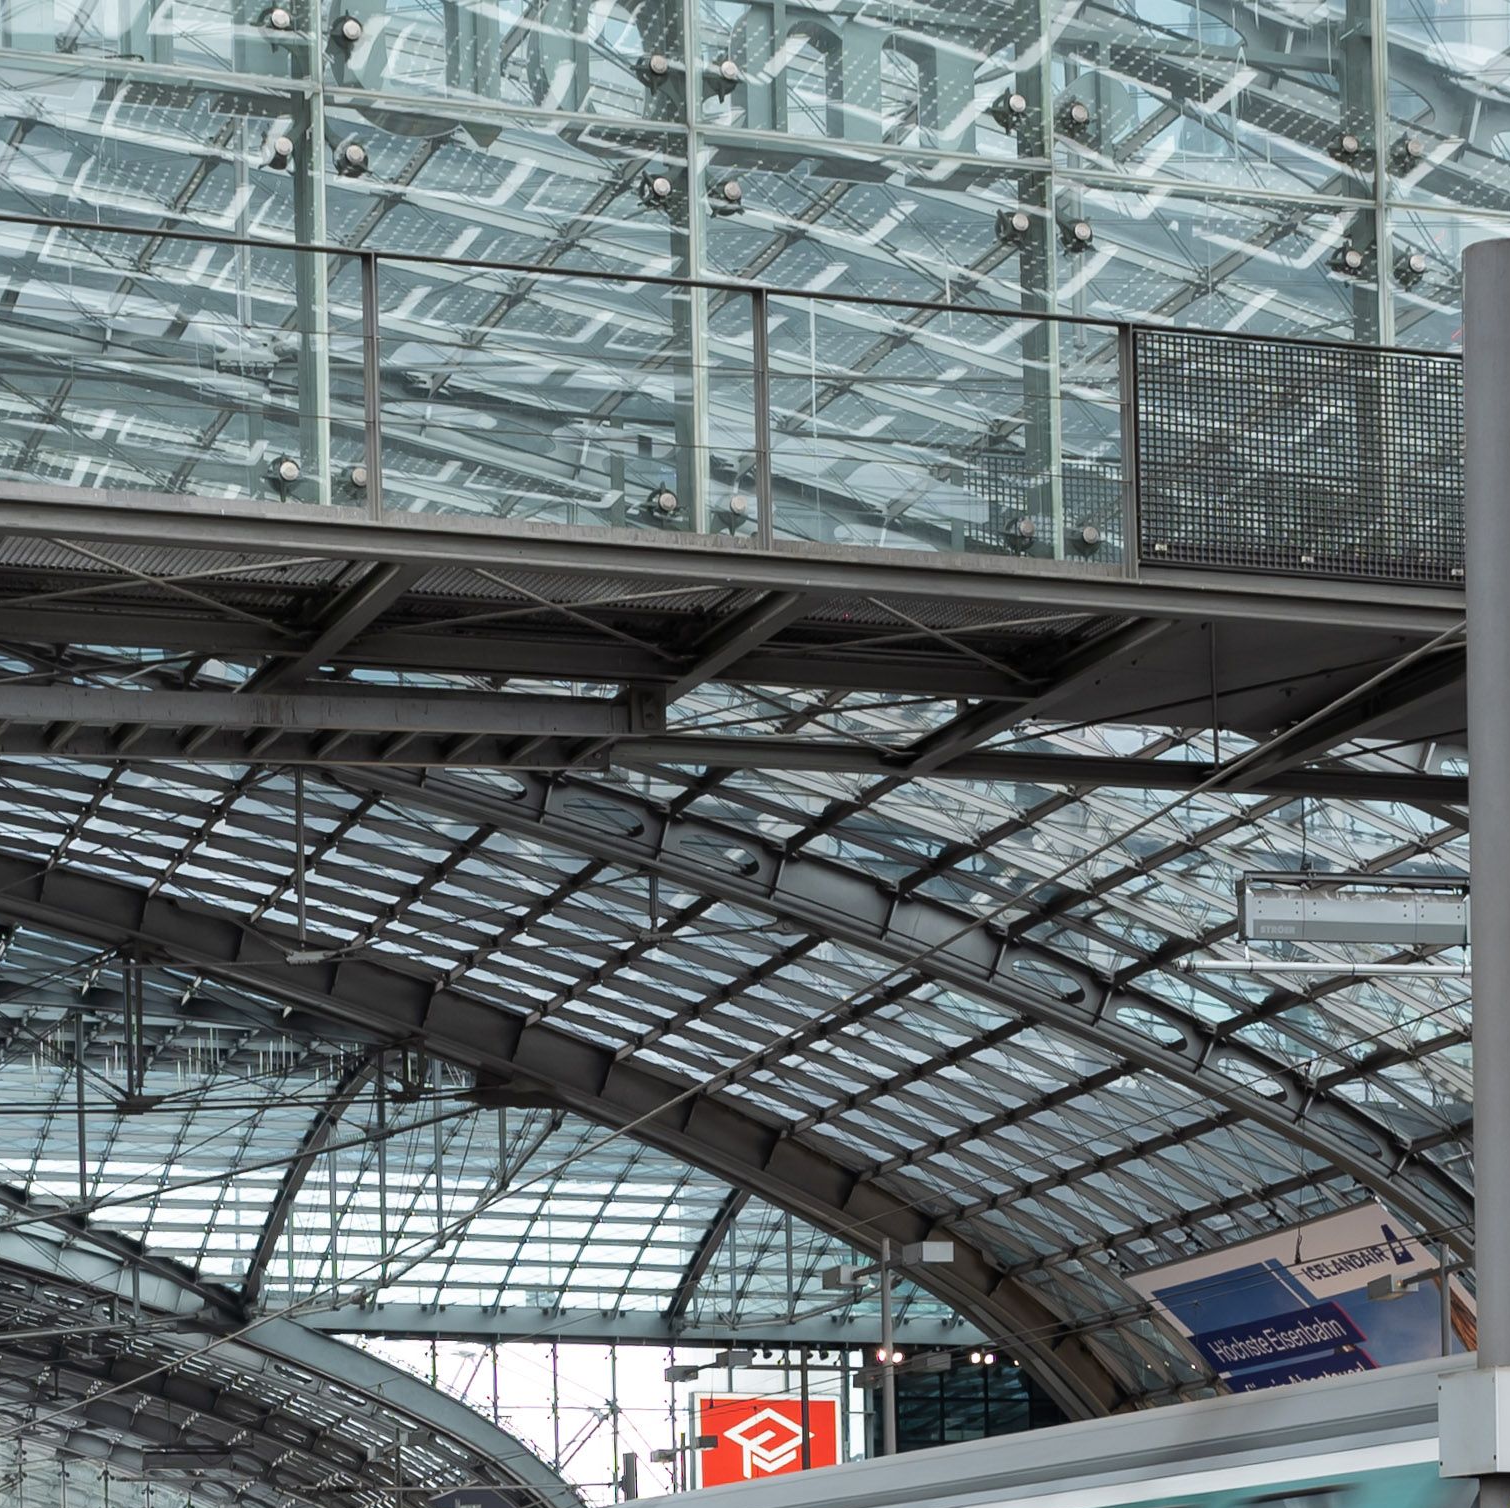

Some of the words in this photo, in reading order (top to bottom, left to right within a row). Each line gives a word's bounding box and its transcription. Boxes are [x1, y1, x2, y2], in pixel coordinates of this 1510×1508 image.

[1301, 1246, 1390, 1282] ICELANDAIR
[1207, 1334, 1275, 1363] Höchste
[1262, 1316, 1347, 1351] Eisenbahn
